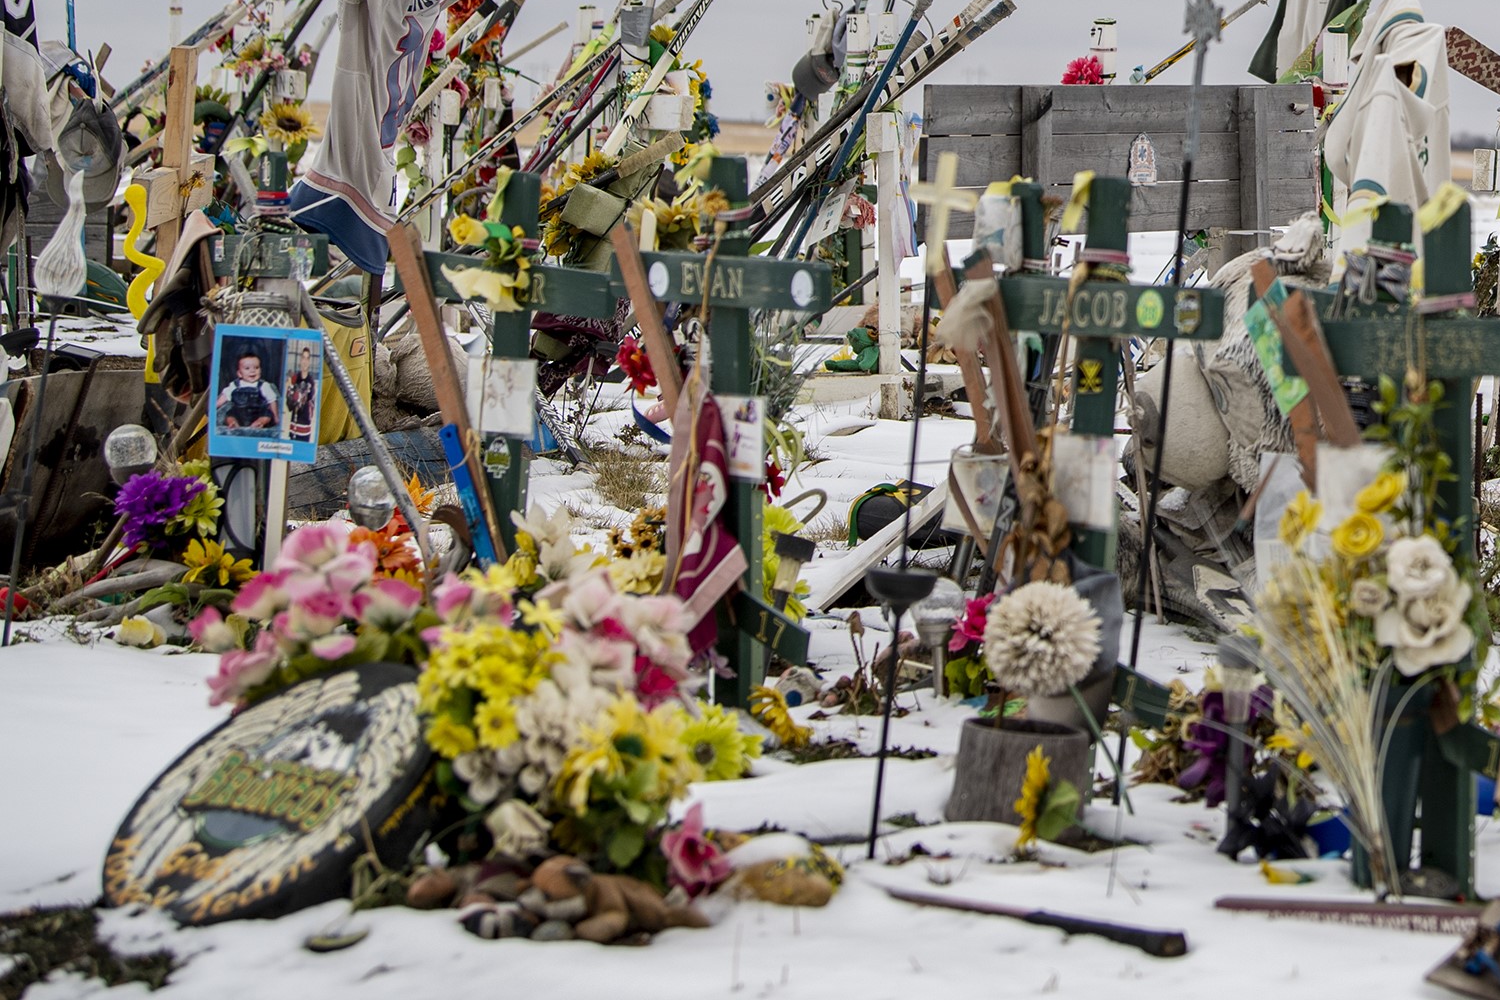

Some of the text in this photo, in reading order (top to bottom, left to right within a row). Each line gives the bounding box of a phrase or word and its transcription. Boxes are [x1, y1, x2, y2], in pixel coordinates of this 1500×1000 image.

[680, 261, 745, 299] EVAN
[1038, 289, 1129, 329] JACOB
[755, 609, 787, 651] 17
[180, 751, 357, 832] BRONCOS
